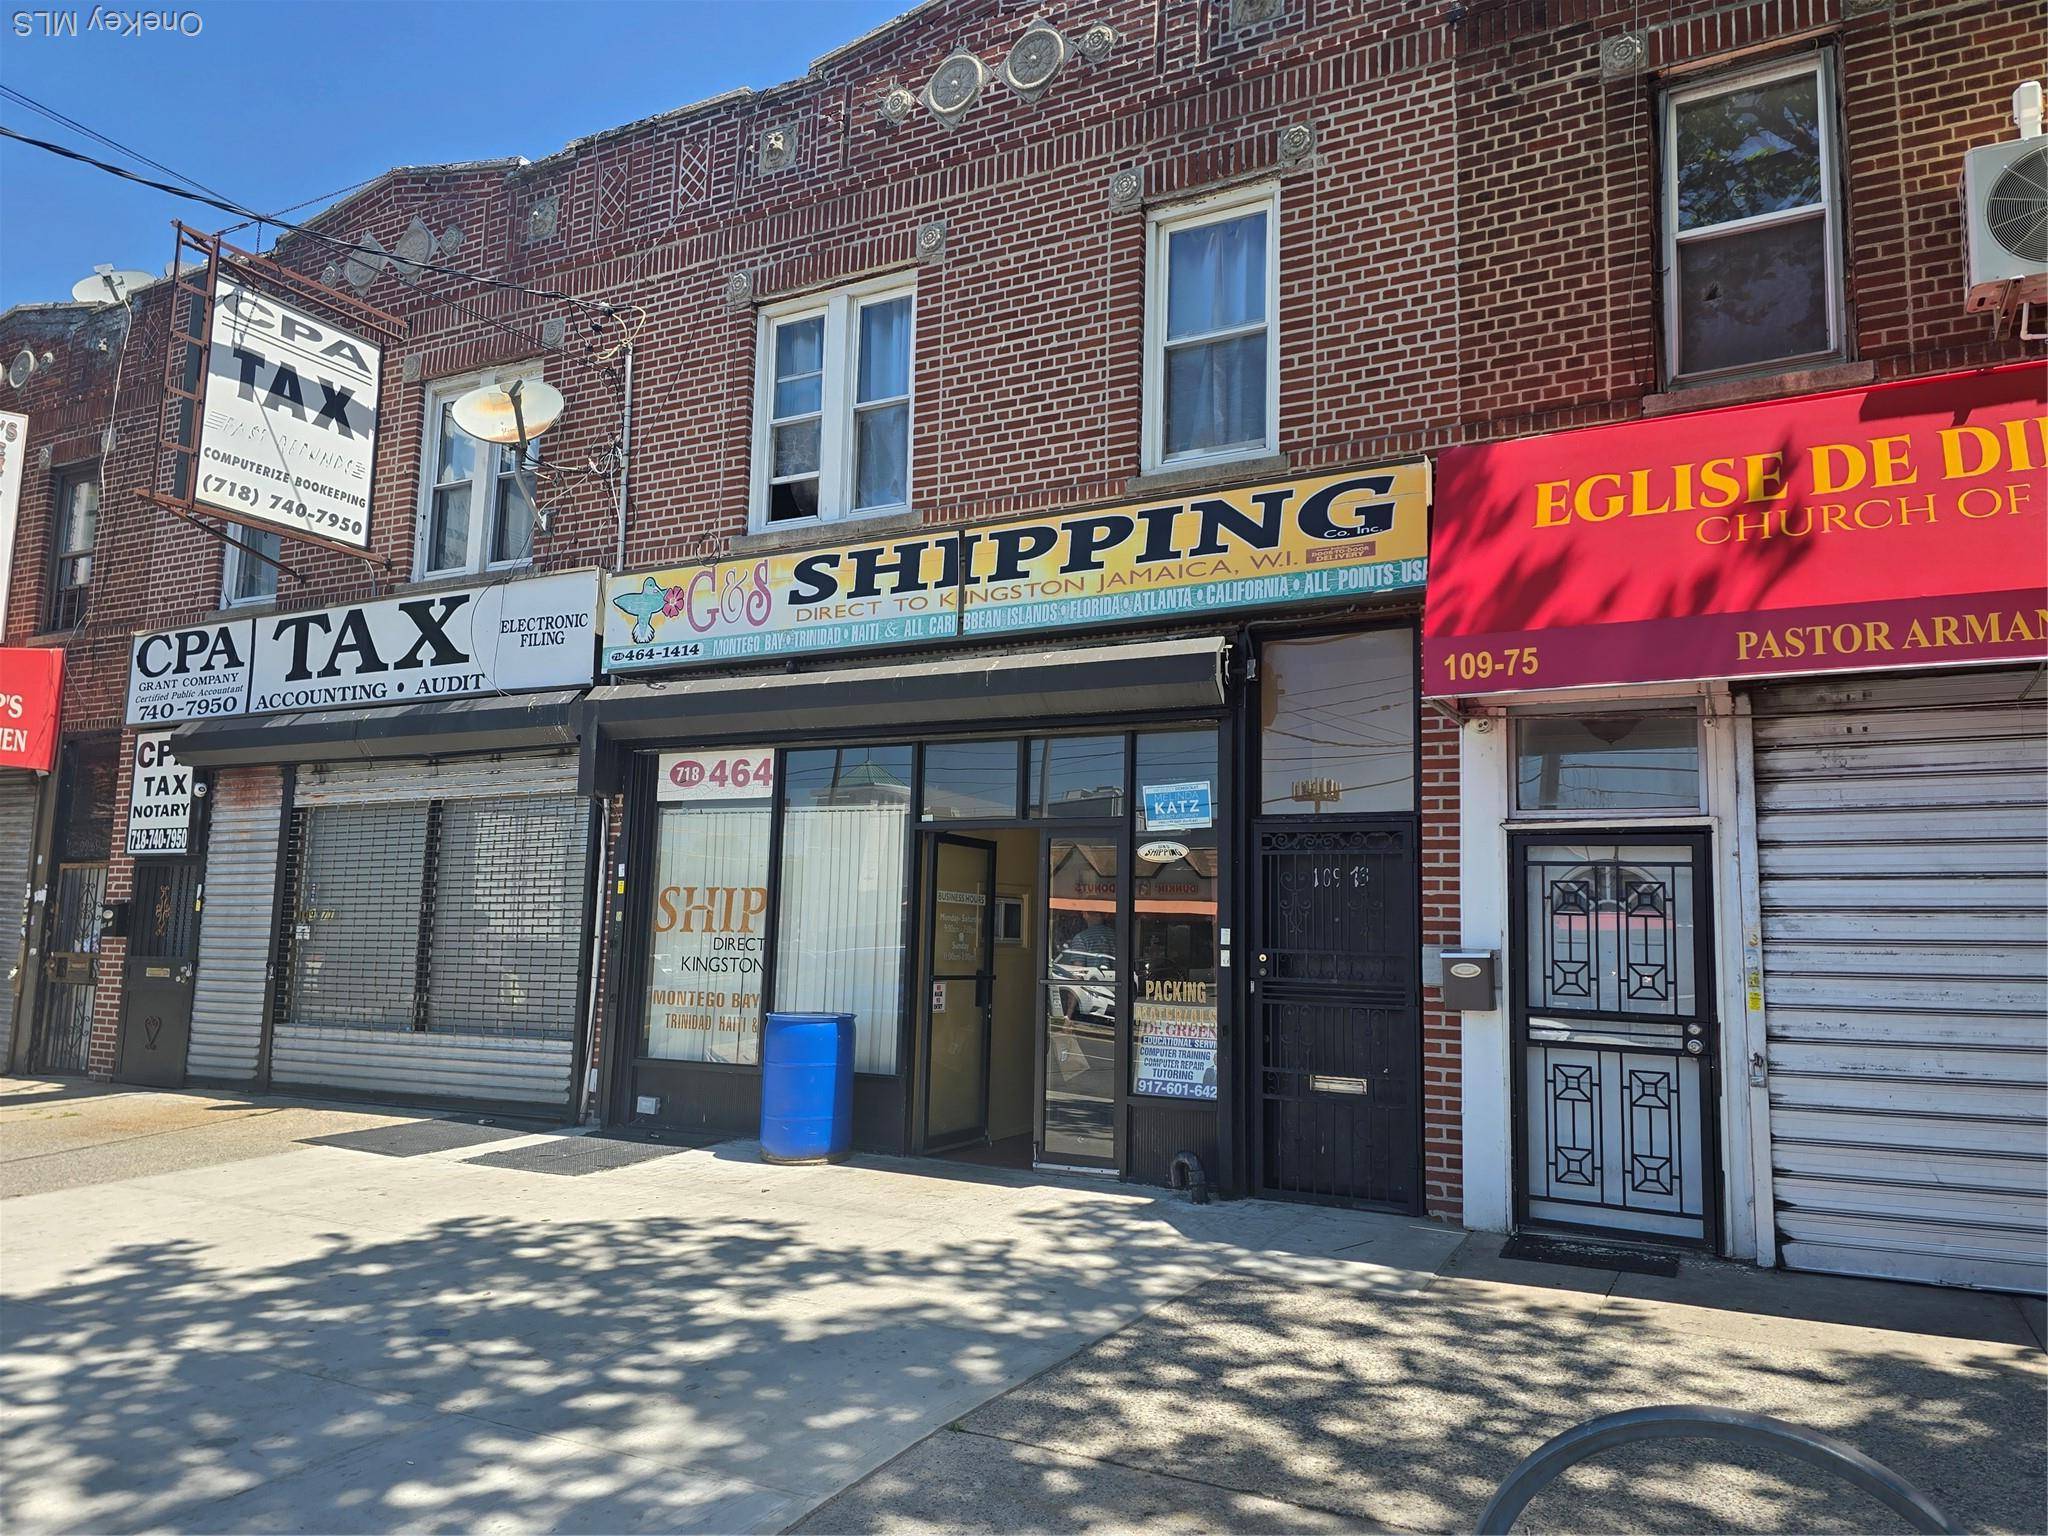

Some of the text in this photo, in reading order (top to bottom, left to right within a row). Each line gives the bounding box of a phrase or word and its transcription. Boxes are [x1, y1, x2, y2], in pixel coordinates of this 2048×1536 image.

[223, 289, 372, 375] CPA
[233, 348, 355, 440] TAX
[204, 447, 366, 508] COMPUTERIZE BOOKEEPING
[1533, 451, 1790, 528] EGLISE
[1806, 434, 1919, 497] DE
[203, 474, 362, 536] (718) 740-7950
[1696, 484, 2032, 545] CHURCH OF
[788, 475, 1398, 605] SHIPPING
[1323, 526, 1383, 538] Co. Inc.
[1316, 551, 1365, 561] DELIVERY
[796, 550, 1299, 622] DIRECT TO KINGSTON JAMAICA, W.I.
[713, 637, 761, 656] MONTEGO
[765, 632, 789, 650] BAY
[792, 627, 841, 648] TRINIDAD
[852, 621, 879, 642] HAITI
[884, 620, 897, 638] &
[904, 617, 923, 636] ALL
[928, 607, 1001, 634] CARIBBEAN
[1005, 603, 1058, 627] ISLANDS
[1069, 595, 1121, 619] FLORIDA
[1133, 587, 1191, 612] ATLANTA
[1206, 574, 1289, 605] CALIFORNIA
[1303, 569, 1331, 594] ALL
[1339, 563, 1396, 590] POINTS
[501, 613, 589, 634] ELECTRONIC
[136, 594, 471, 682] CPA TAX
[520, 631, 566, 648] FILING
[625, 643, 700, 661] 464-1414
[1444, 647, 1539, 680] 109-75
[1736, 621, 1895, 661] PASTOR
[138, 672, 240, 692] GRANT COMPANY
[254, 672, 486, 710] ACCOUNTING AUDIT
[135, 684, 244, 704] Certified Public Accountant
[138, 696, 238, 721] 740-7950
[137, 740, 182, 768] CP
[676, 758, 773, 788] 718 464
[144, 774, 188, 797] TAX
[1154, 791, 1201, 802] MELINDA
[1154, 799, 1200, 815] KATZ
[133, 803, 189, 818] NOTARY
[131, 828, 187, 849] 718-740-7950
[1144, 848, 1183, 856] SHIPPING
[1313, 867, 1341, 888] 109
[938, 891, 985, 904] BUSINESS HOURS
[654, 886, 768, 933] SHIP
[713, 937, 768, 952] DIRECT
[681, 956, 765, 973] KINGSTON
[652, 989, 761, 1009] MONTEGO BAY
[1145, 980, 1207, 1003] PACKING
[665, 1013, 758, 1033] TRINIDAD HAITI &
[1142, 1036, 1193, 1048] EDUCATIONAL
[1140, 1046, 1211, 1060] COMPUTER TRAINING
[1144, 1057, 1205, 1071] COMPUTER REPAIR
[1152, 1068, 1194, 1081] TUTORING
[1138, 1080, 1217, 1098] 917-601-642
